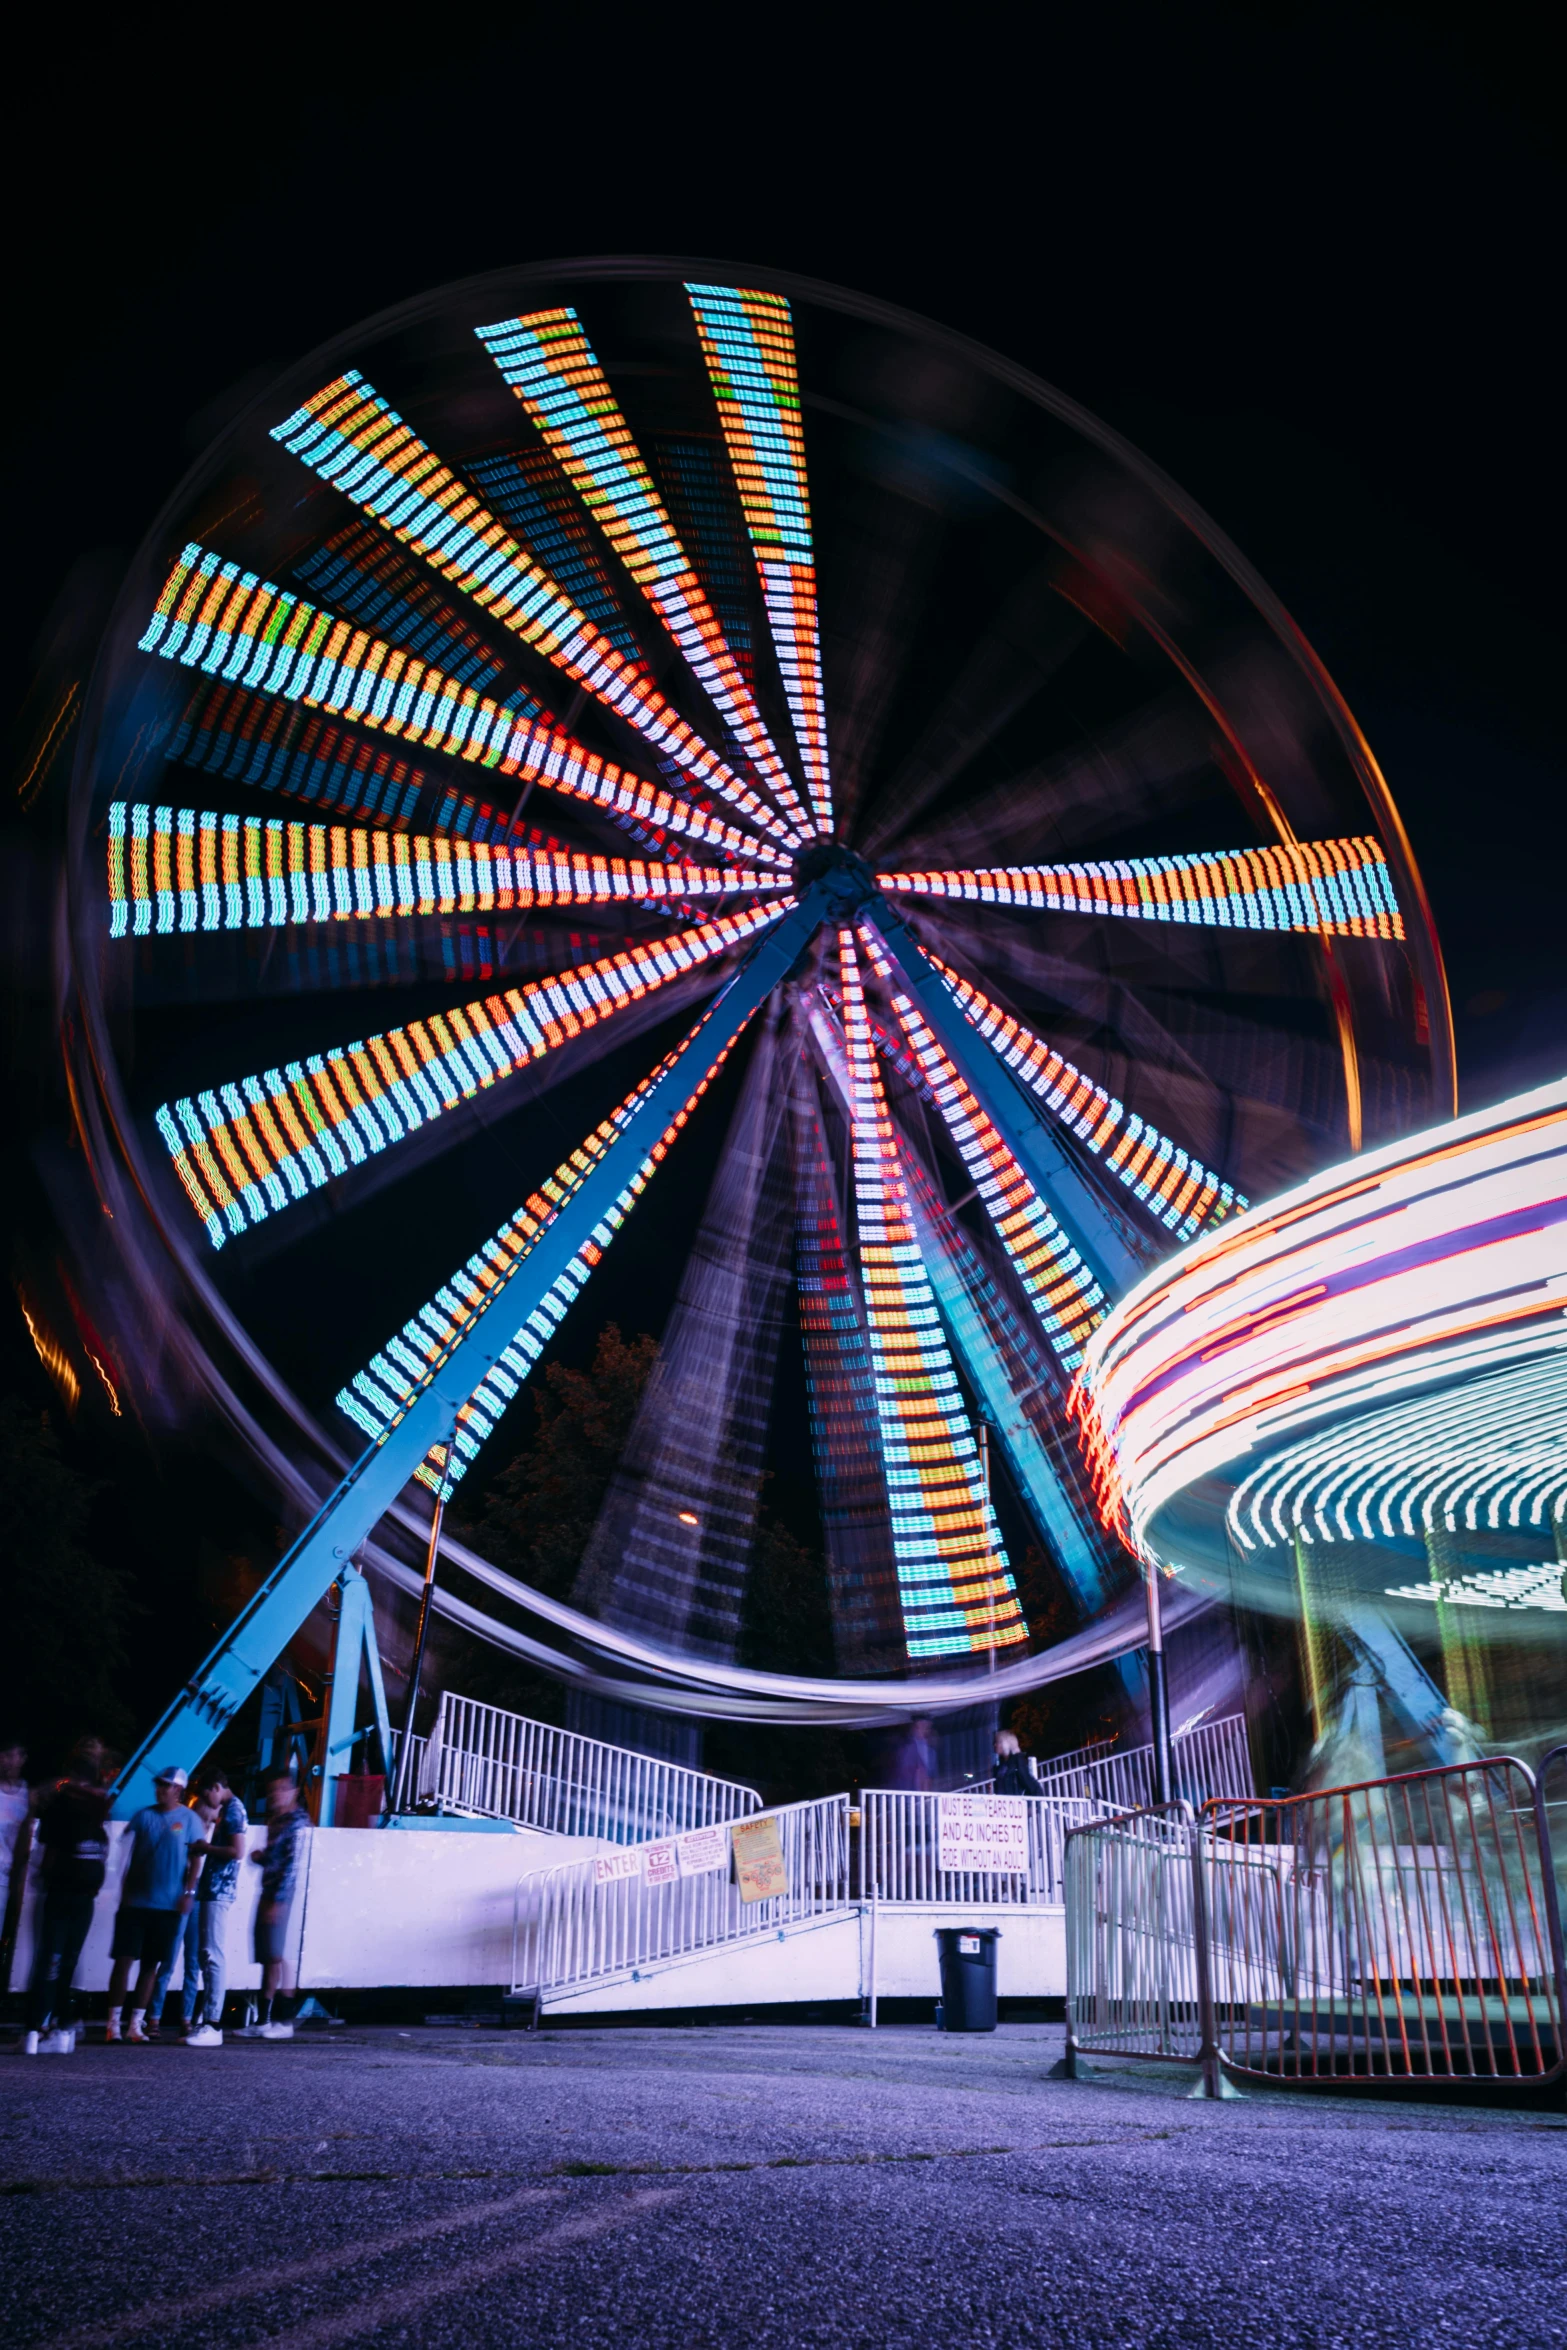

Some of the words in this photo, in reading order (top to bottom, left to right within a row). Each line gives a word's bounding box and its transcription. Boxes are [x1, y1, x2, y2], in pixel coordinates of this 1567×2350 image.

[942, 1797, 961, 1816] MUST
[963, 1798, 973, 1817] BE
[985, 1799, 1007, 1818] YEARS
[1009, 1800, 1023, 1819] OLD
[739, 1819, 768, 1833] SAFETY
[943, 1822, 961, 1841] AND
[964, 1823, 974, 1842] 42
[976, 1823, 1009, 1843] INCHES
[1011, 1825, 1023, 1843] TO
[597, 1852, 639, 1879] ENTER
[651, 1851, 669, 1866] 12
[943, 1848, 958, 1867] RIDE
[962, 1849, 991, 1868] WITHOUT
[993, 1850, 1002, 1868] AN
[1005, 1850, 1024, 1869] ADULT
[648, 1864, 675, 1877] CREDITS
